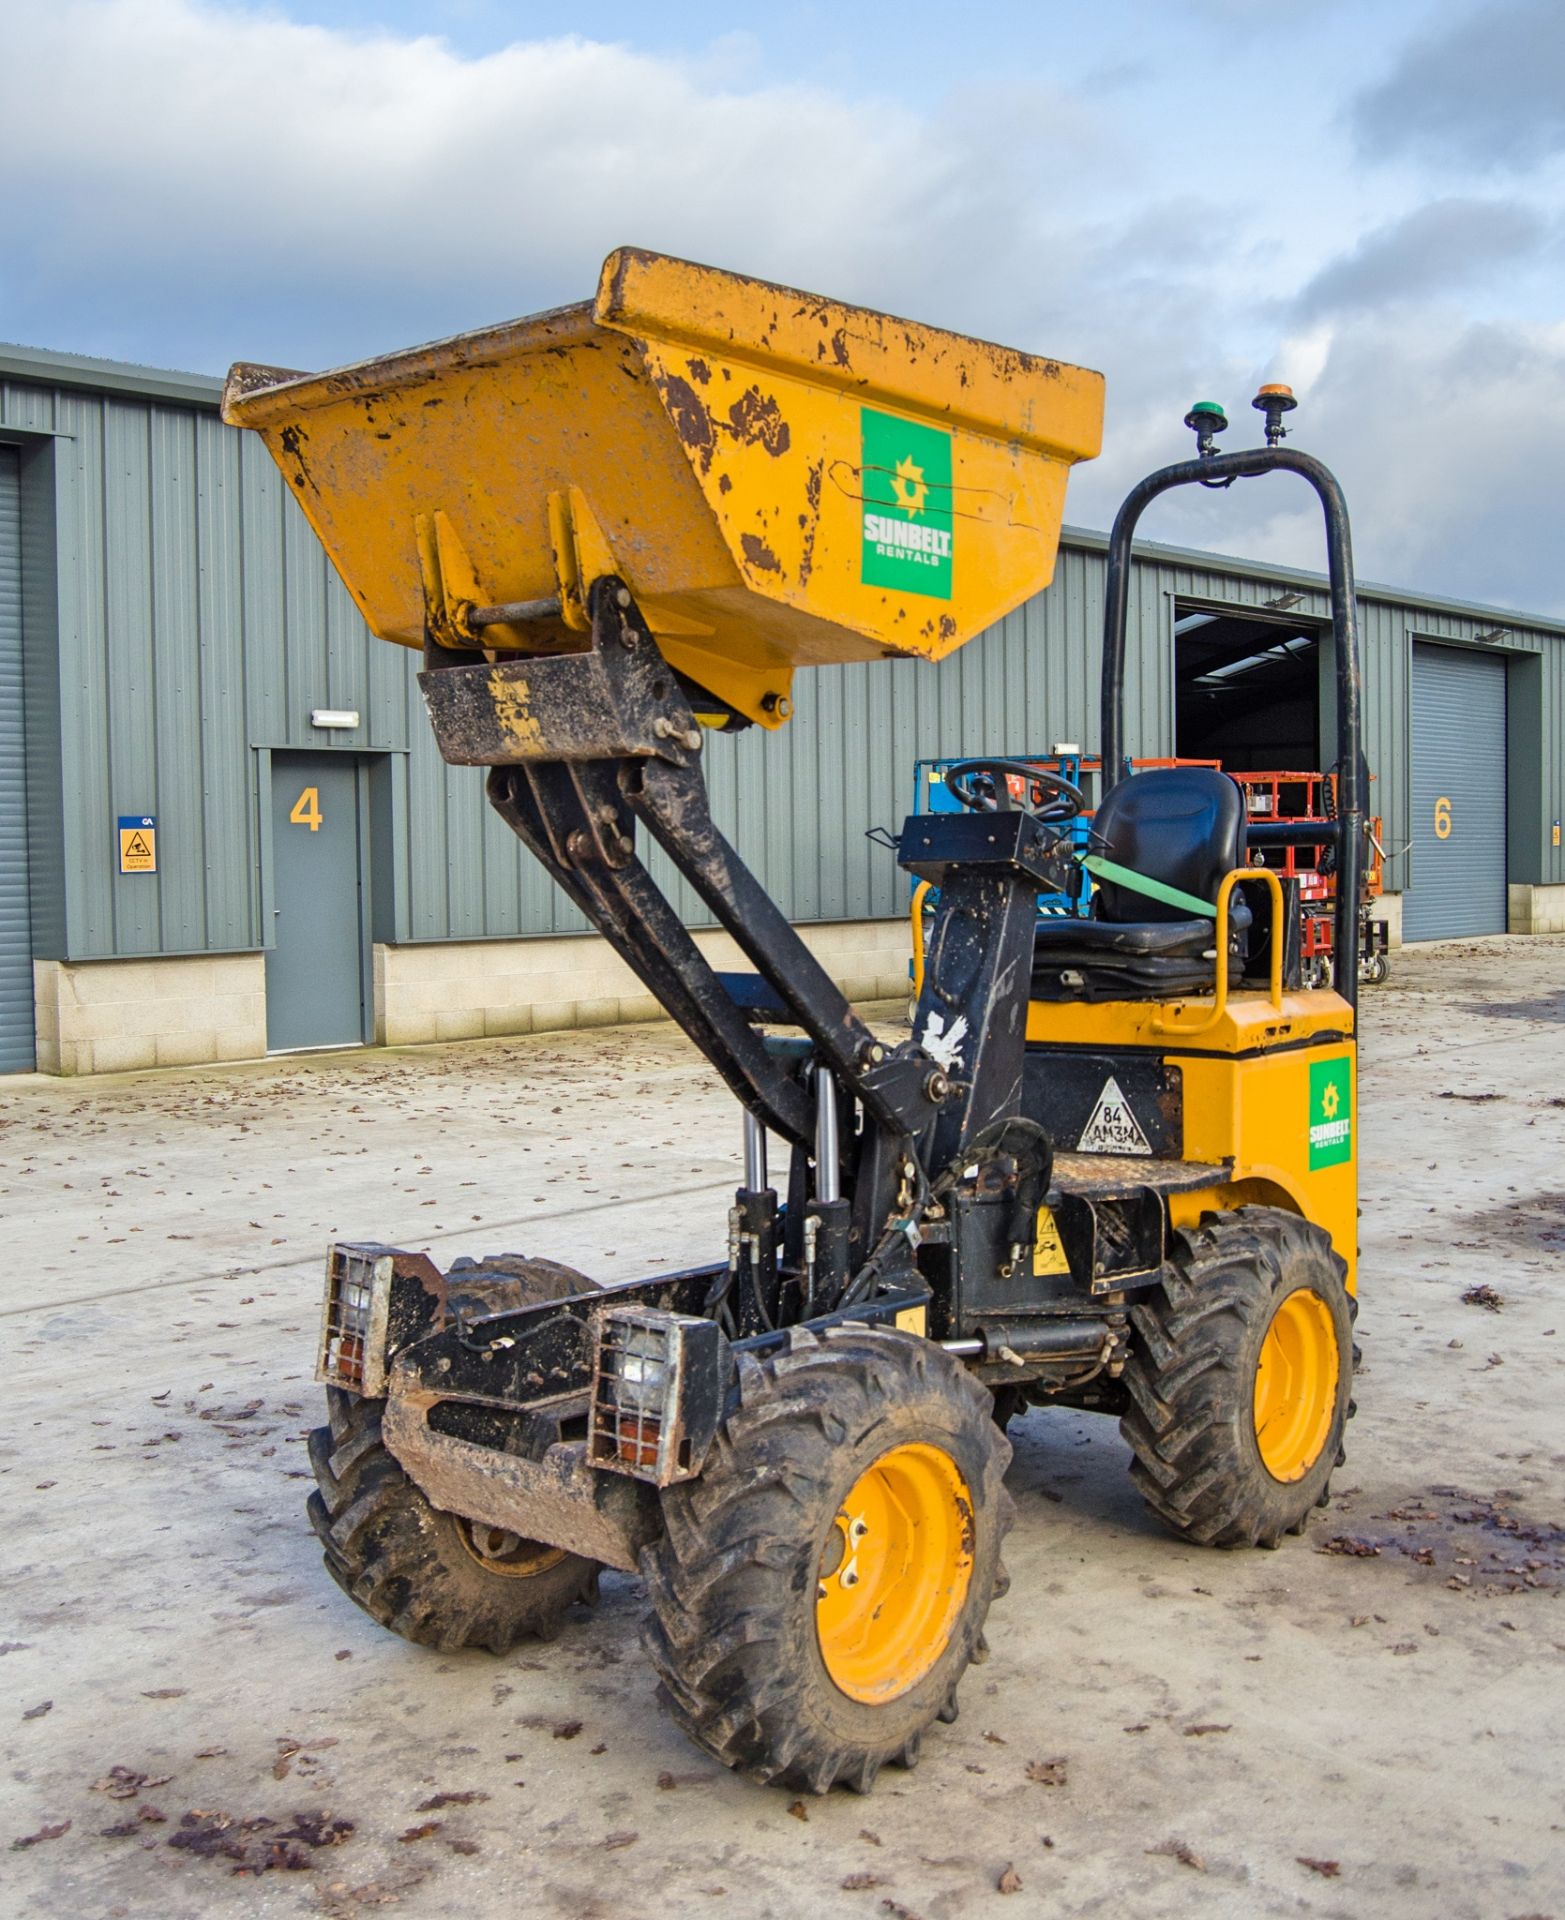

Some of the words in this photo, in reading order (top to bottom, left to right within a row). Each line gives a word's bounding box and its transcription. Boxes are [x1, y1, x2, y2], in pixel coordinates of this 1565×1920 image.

[864, 513, 952, 559] SUNBELT
[876, 544, 940, 567] RENTALS
[290, 787, 323, 832] 4
[1434, 796, 1452, 840] 6
[1103, 1107, 1122, 1124] 84
[1310, 1118, 1350, 1143] SUNBELT
[1314, 1135, 1345, 1149] RENTALS
